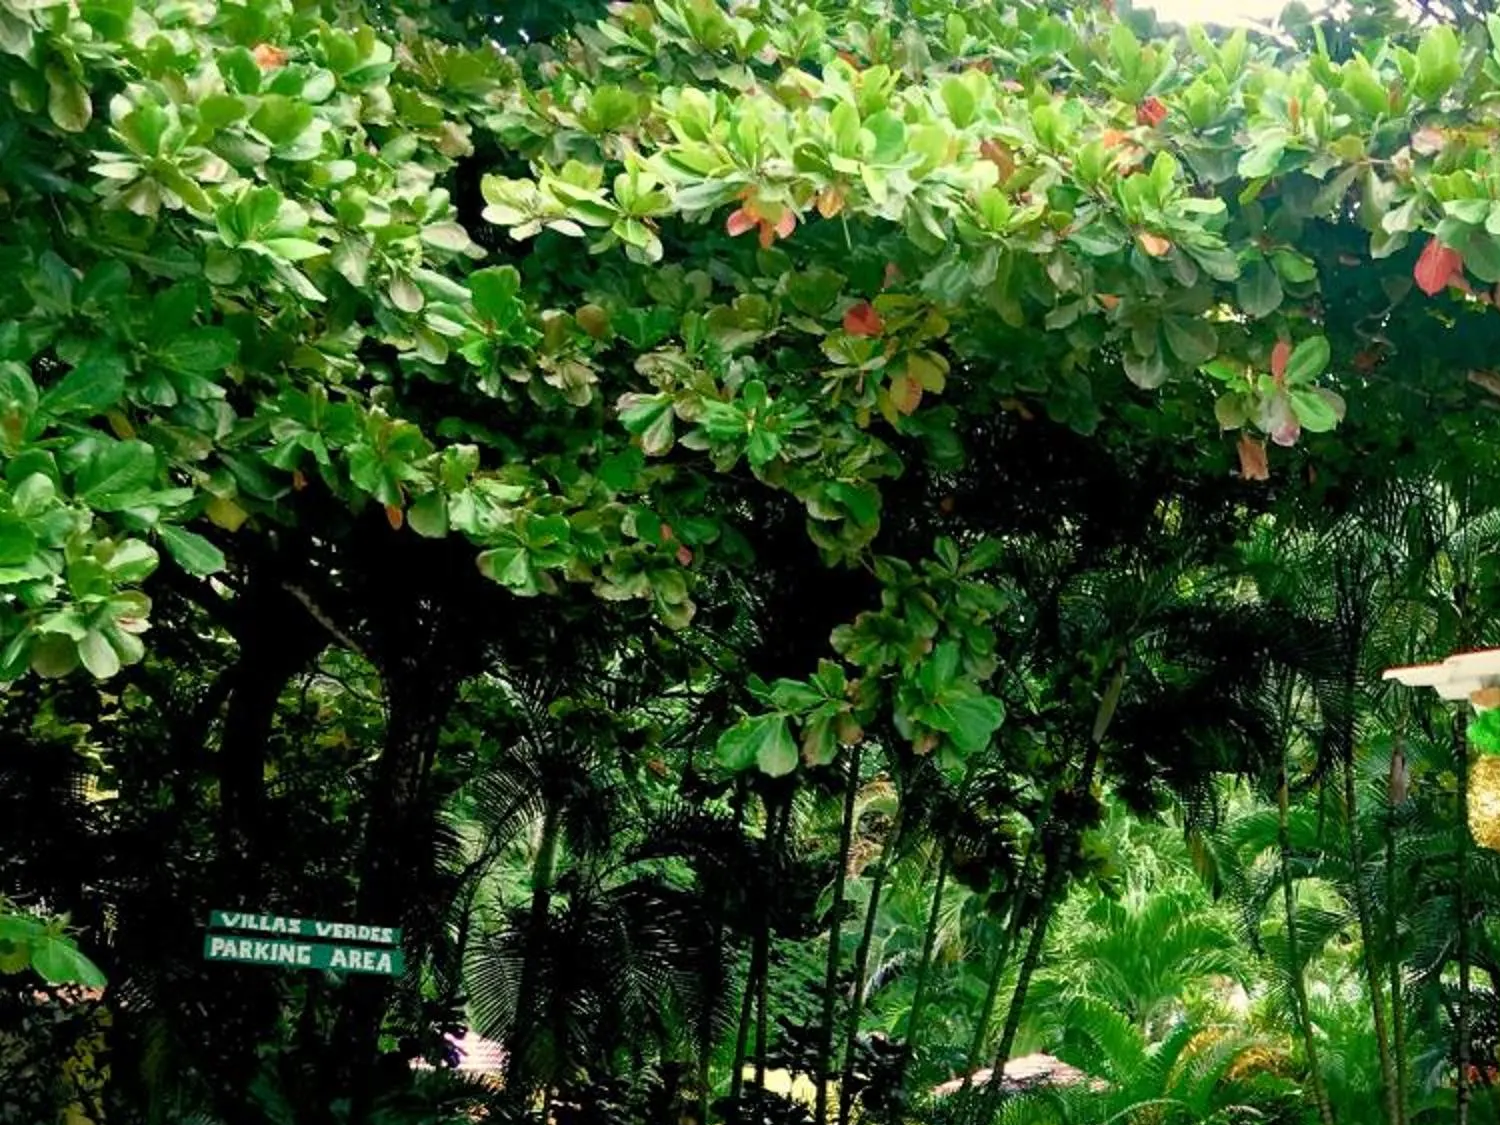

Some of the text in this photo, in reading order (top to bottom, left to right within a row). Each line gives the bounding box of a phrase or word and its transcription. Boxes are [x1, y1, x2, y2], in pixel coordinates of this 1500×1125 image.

[221, 912, 393, 943] VILLAS VERDES
[210, 937, 393, 973] PARKING AREA
